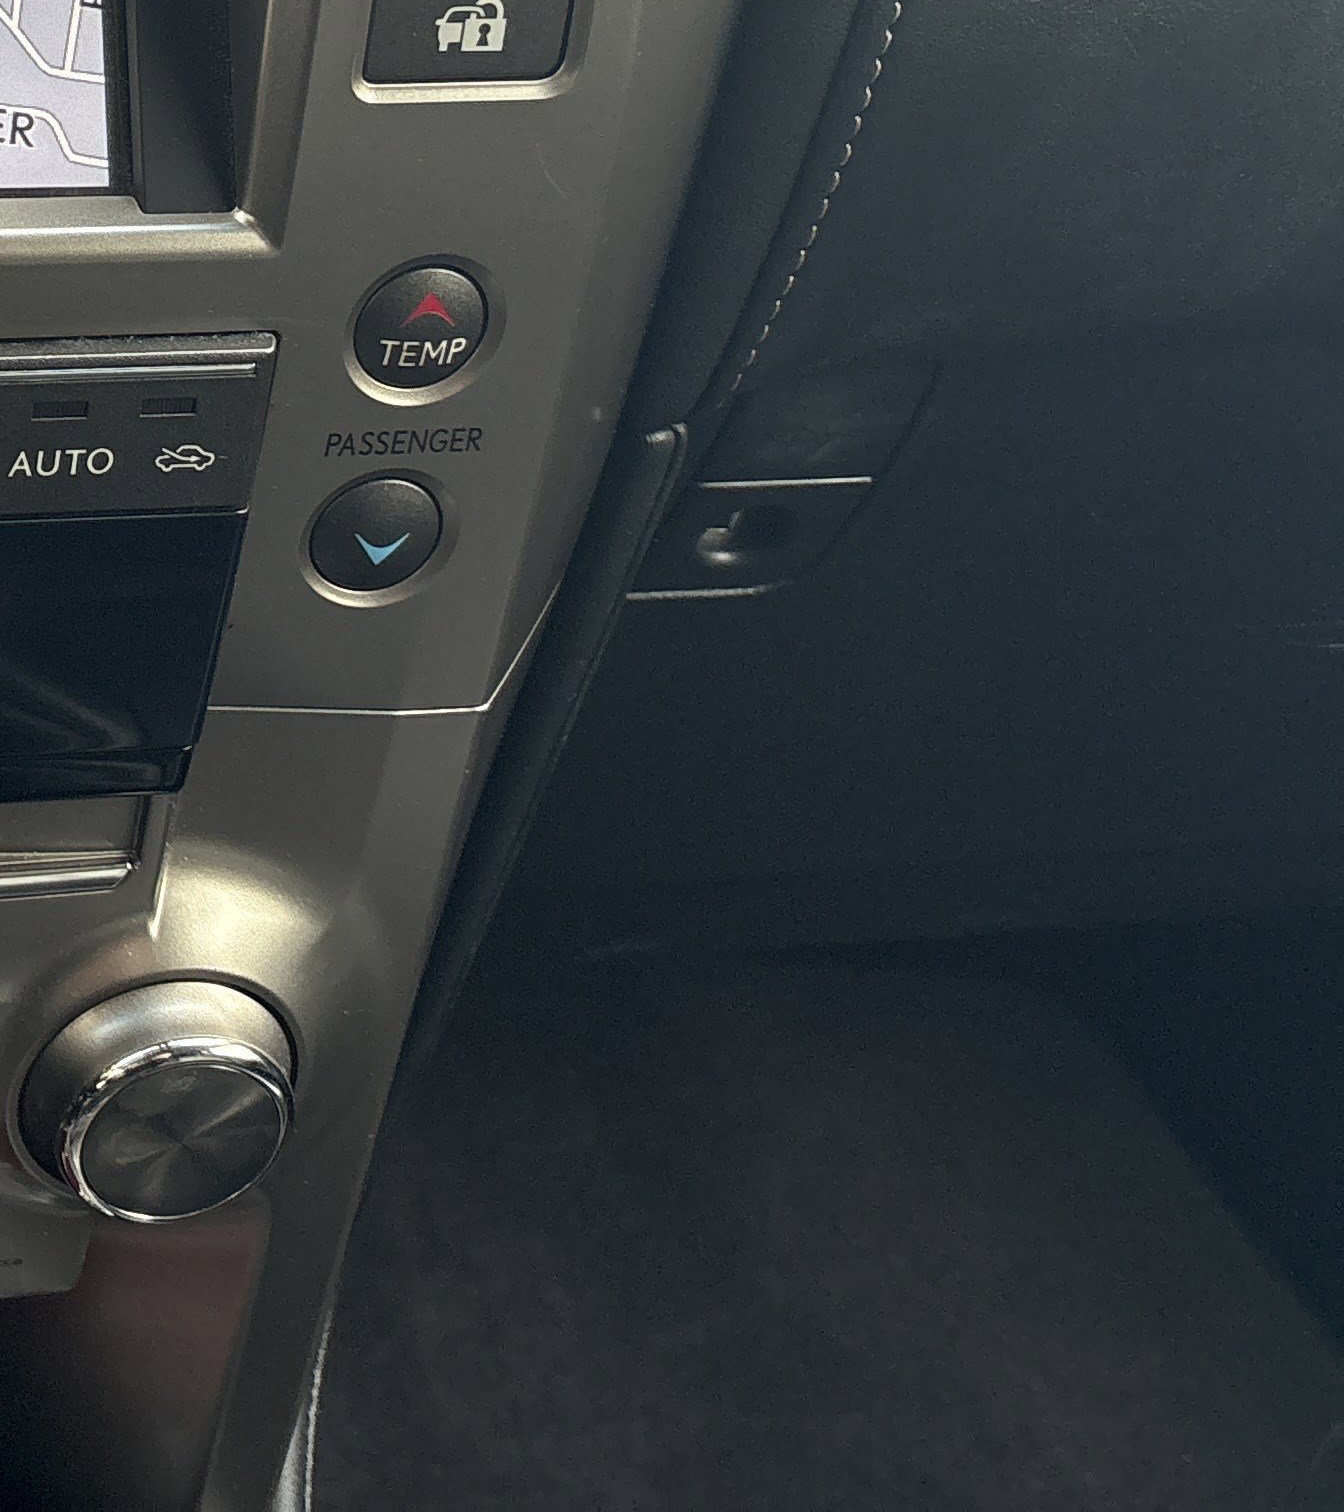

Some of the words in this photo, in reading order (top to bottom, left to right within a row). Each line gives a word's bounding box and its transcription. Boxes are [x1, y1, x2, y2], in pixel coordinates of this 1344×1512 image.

[380, 337, 468, 368] TEMP
[324, 427, 484, 457] PASSENGER
[8, 447, 115, 478] AUTO
